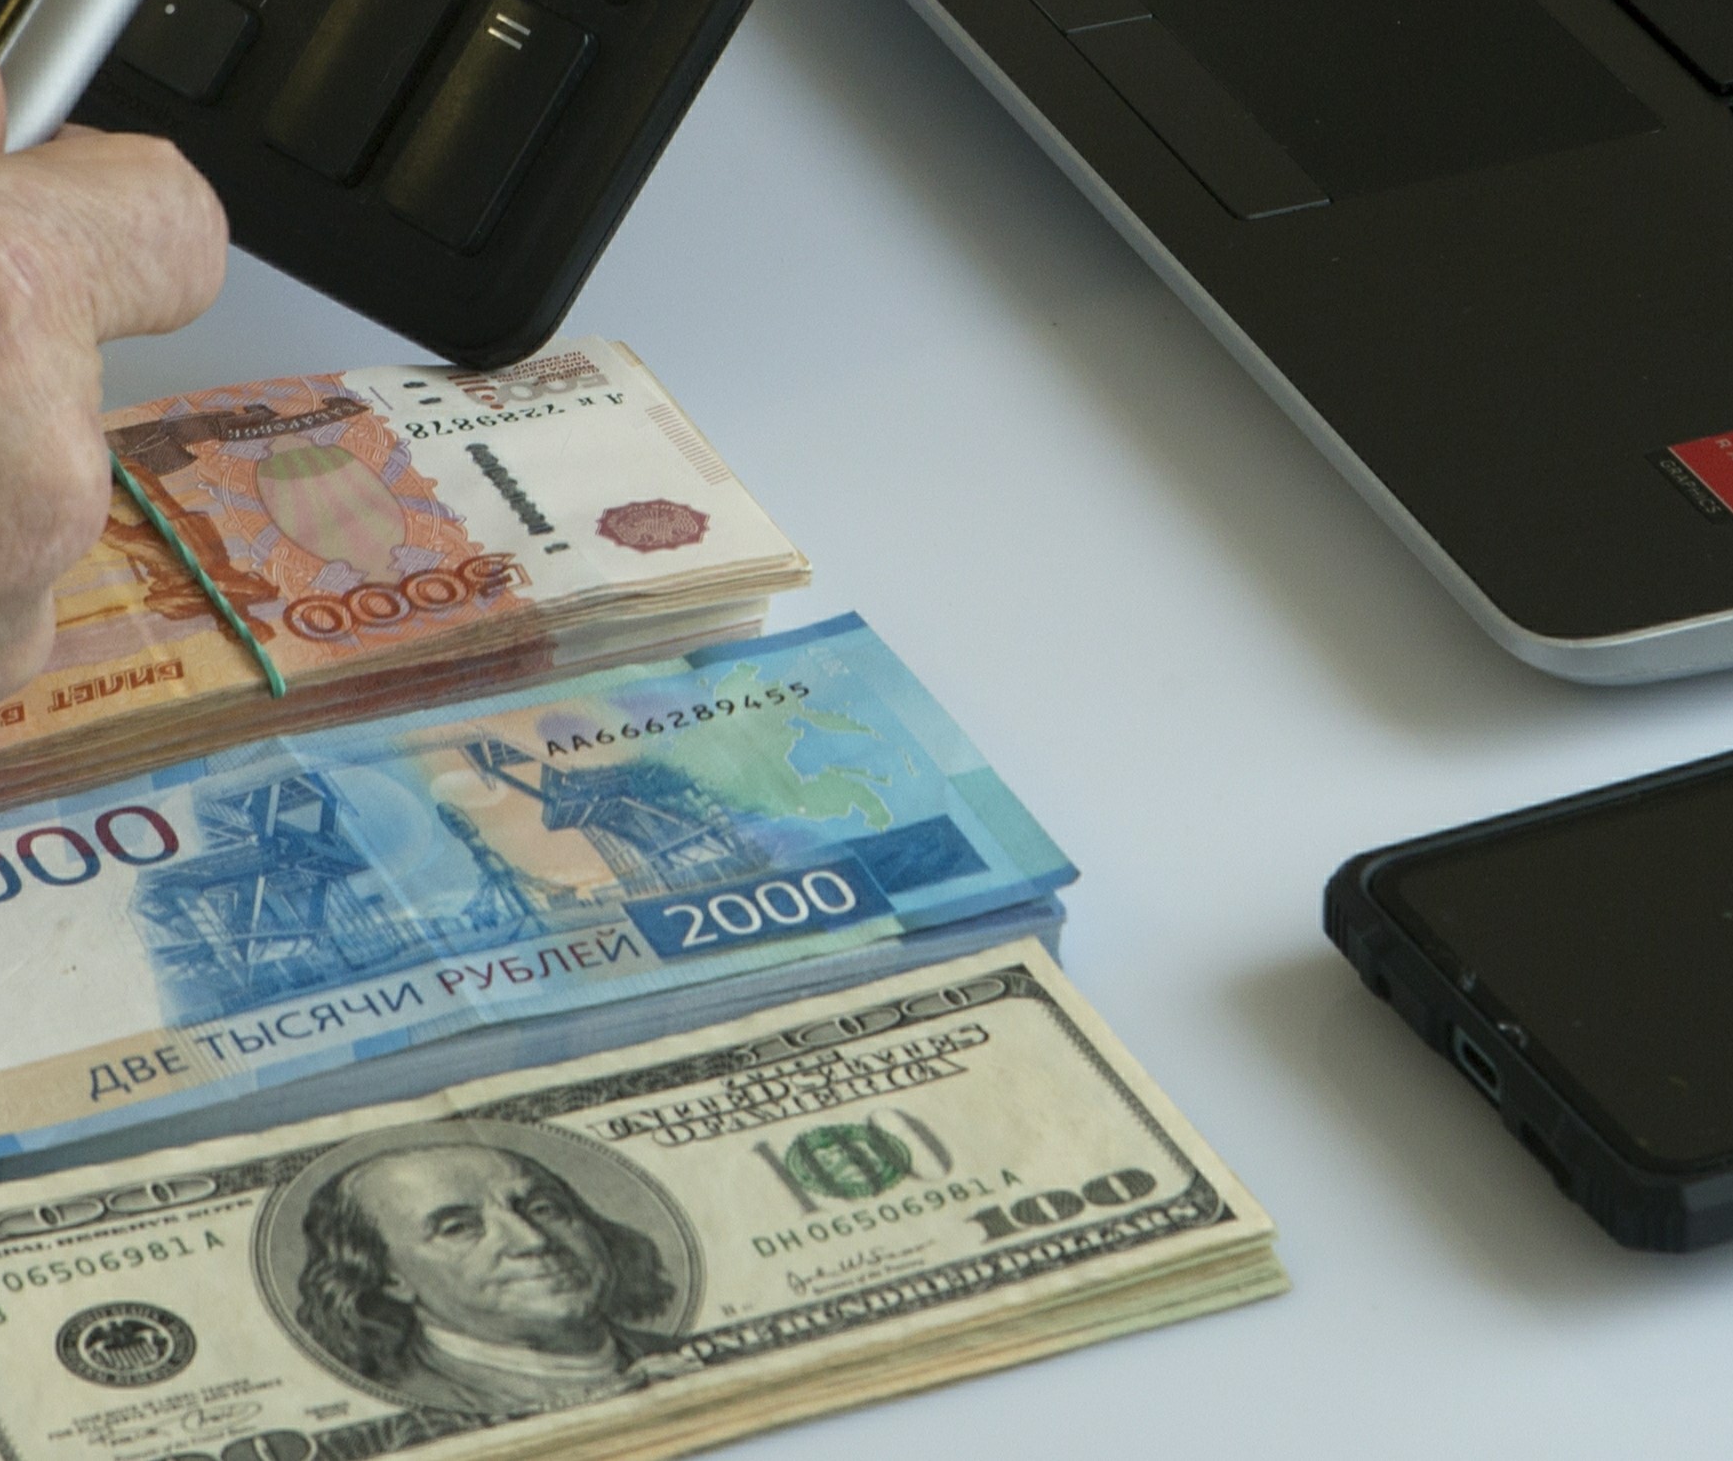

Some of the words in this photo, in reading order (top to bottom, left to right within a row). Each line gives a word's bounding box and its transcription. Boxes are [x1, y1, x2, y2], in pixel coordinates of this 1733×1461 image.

[1660, 460, 1721, 515] GRAPHICS
[283, 553, 532, 639] 5000
[51, 659, 185, 713] БИЛЕТ
[663, 871, 855, 948] 2000
[87, 1044, 187, 1101] ДВЕ
[194, 982, 424, 1064] ТЫСЯЧИ
[435, 928, 641, 996] РУБЛЕЙ
[965, 1167, 1158, 1241] 100
[780, 1262, 1008, 1336] HUNDRED
[1008, 1200, 1202, 1275] DOLLARS
